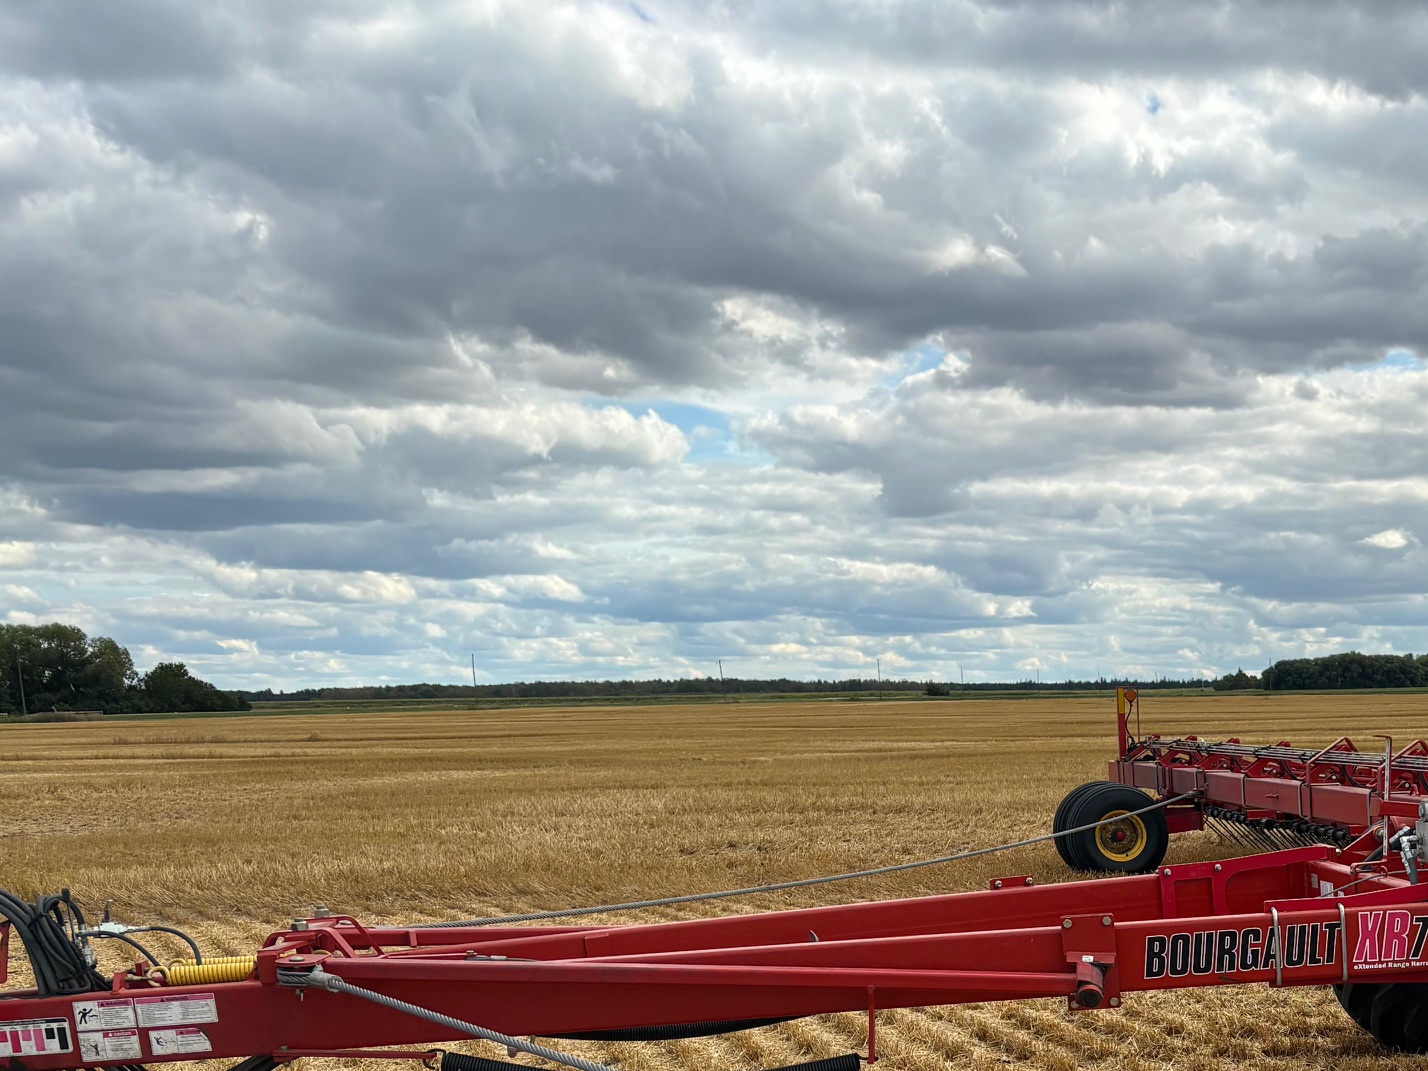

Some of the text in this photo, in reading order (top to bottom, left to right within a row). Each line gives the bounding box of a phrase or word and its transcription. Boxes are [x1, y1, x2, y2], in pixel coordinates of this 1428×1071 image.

[1144, 922, 1341, 979] BOURGAULT
[1353, 962, 1387, 970] eXtended
[1388, 961, 1410, 969] Range
